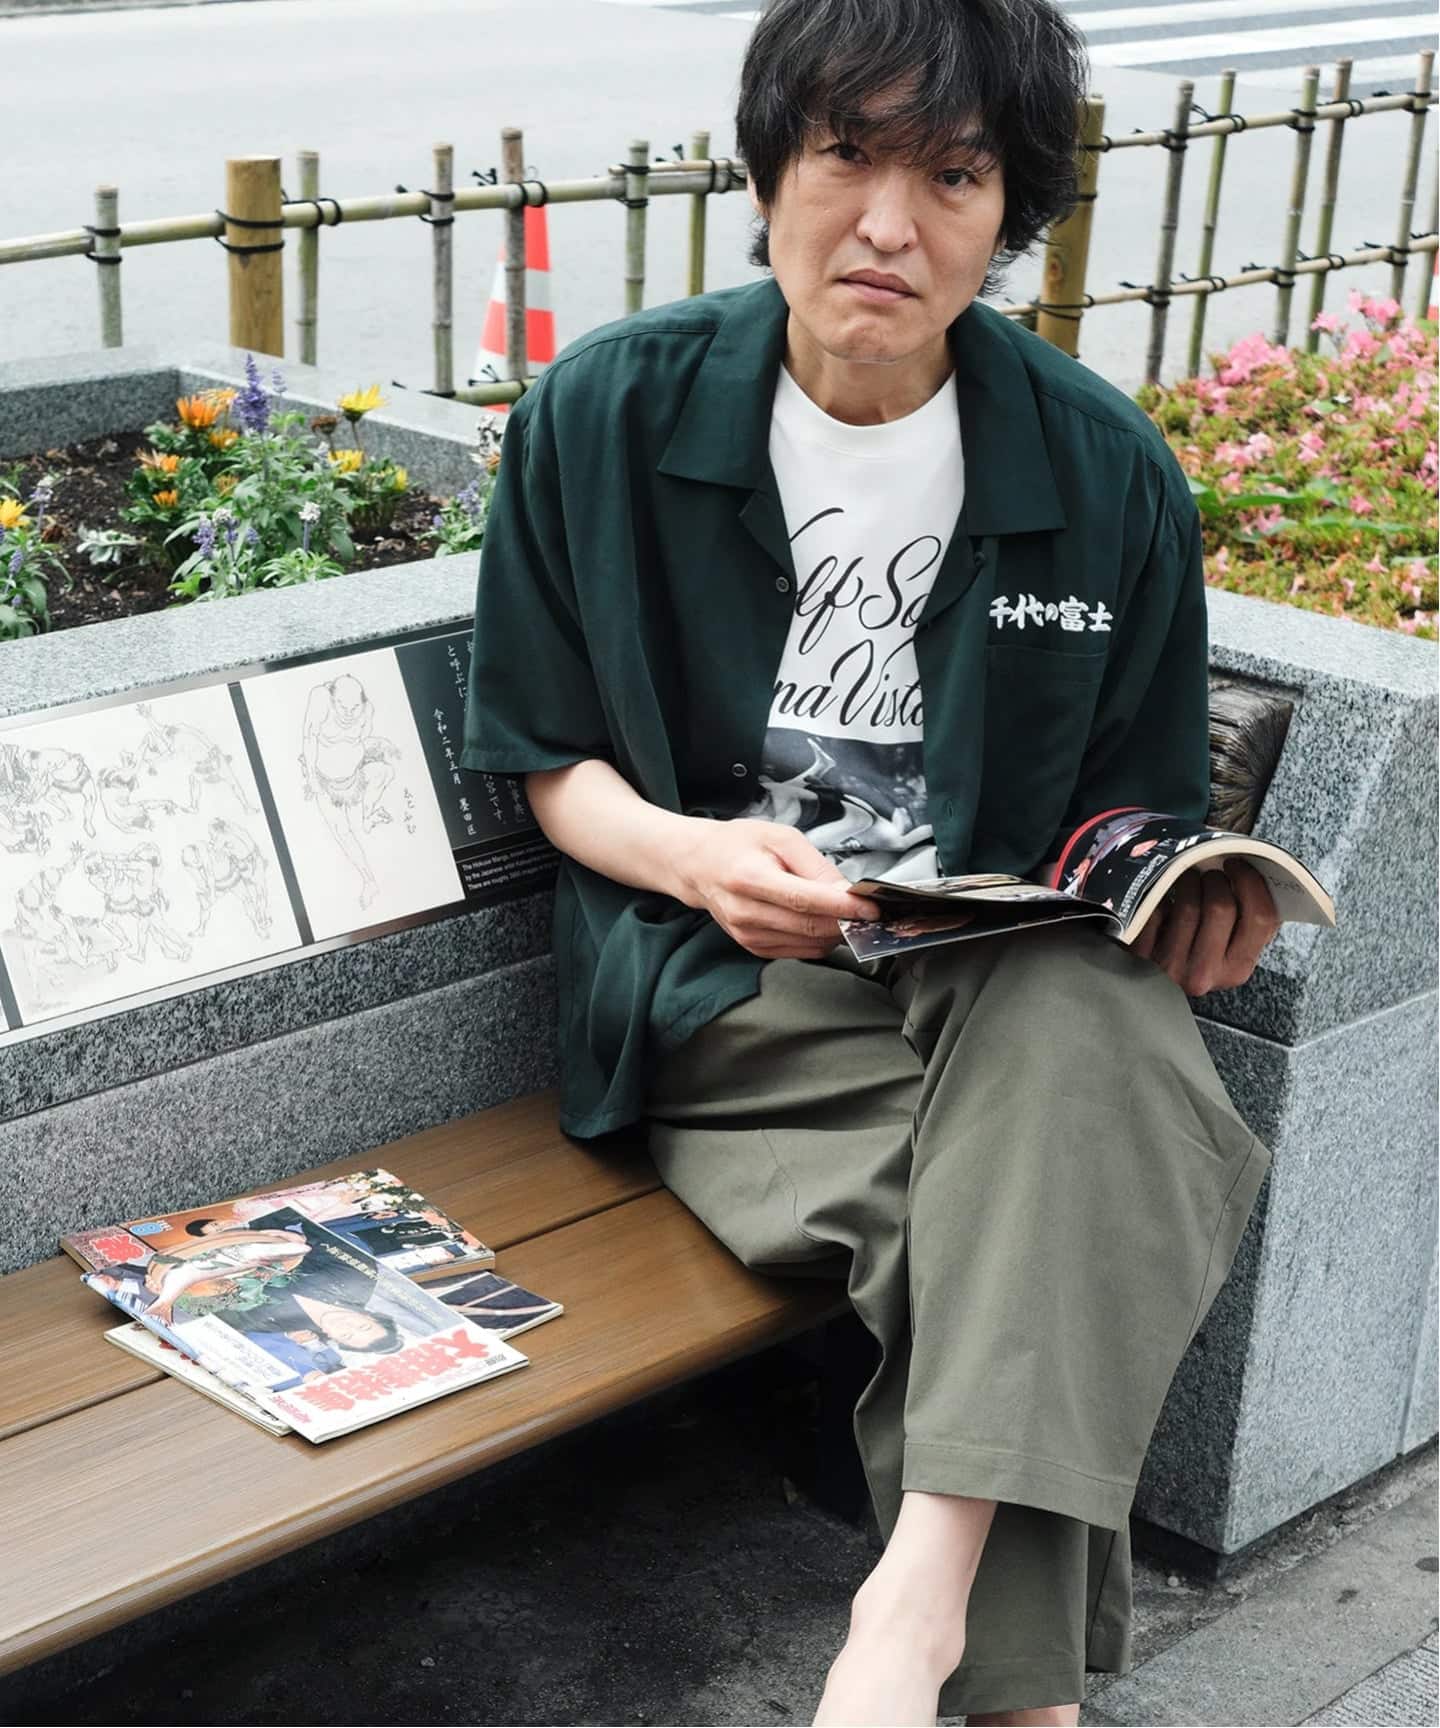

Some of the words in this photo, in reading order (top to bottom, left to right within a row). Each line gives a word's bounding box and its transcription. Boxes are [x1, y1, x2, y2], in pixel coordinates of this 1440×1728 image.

[790, 508, 863, 655] lf
[989, 593, 1113, 632] 千代の富士
[467, 882, 482, 891] There
